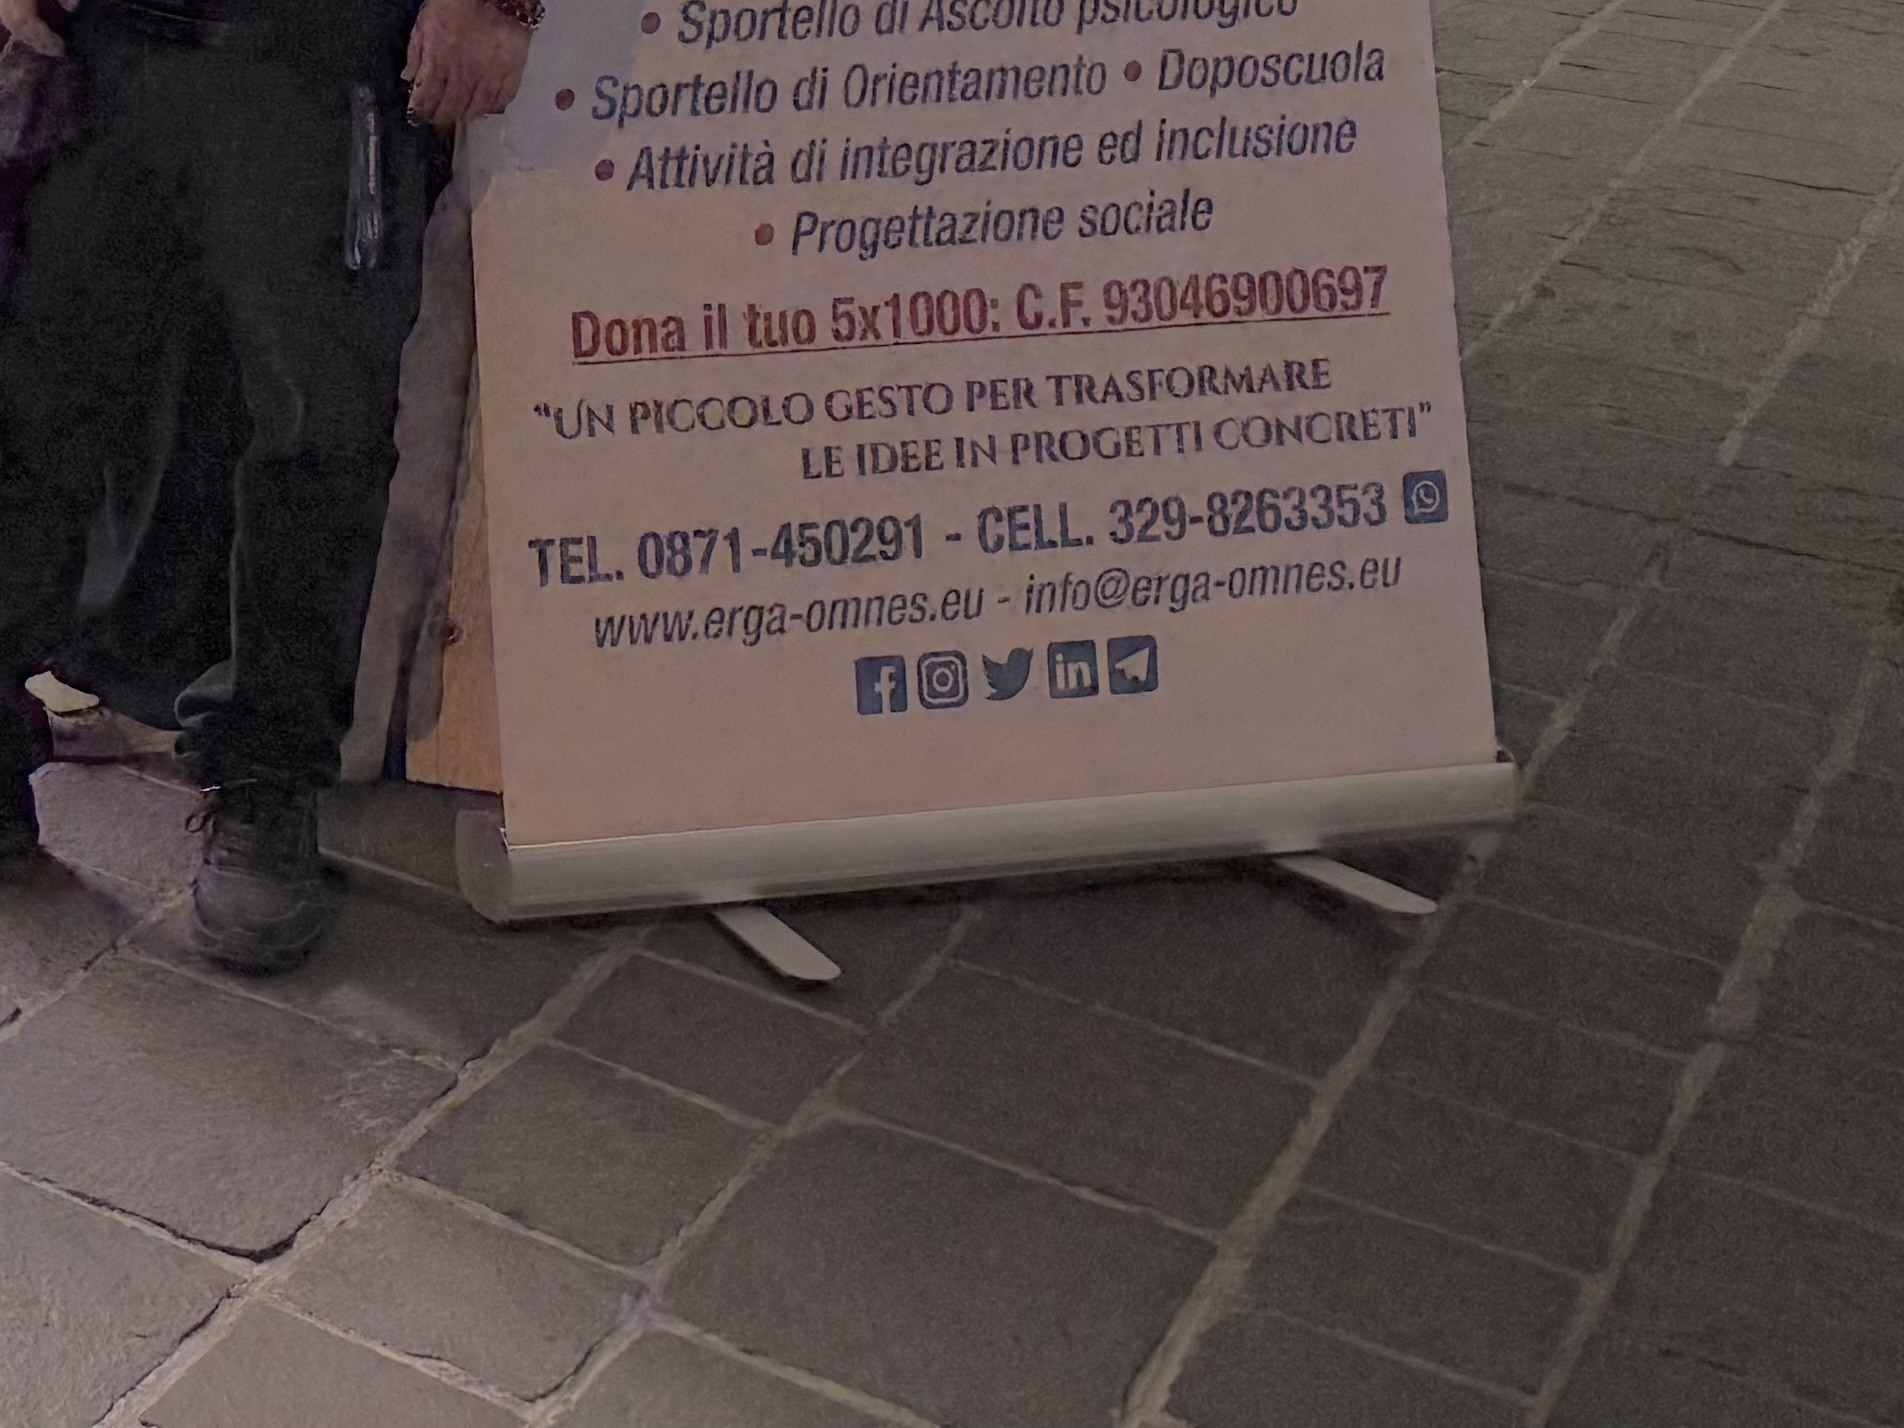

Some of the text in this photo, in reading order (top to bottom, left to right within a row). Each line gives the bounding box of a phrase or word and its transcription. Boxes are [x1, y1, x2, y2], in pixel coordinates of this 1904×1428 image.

[592, 44, 1385, 128] Sportello di Orientamento Doposcuola
[628, 117, 1357, 192] Attività di integrazione ed inclusione
[793, 190, 1213, 259] Progettazione sociale
[571, 266, 1387, 358] Dona tuo 5x1000: C.F. 93046900697
[628, 389, 815, 432] PICCOLO
[825, 382, 954, 422] GESTO
[965, 375, 1037, 412] PER
[1049, 356, 1331, 405] TRASFORMARE
[801, 448, 844, 480] LE
[857, 437, 945, 476] IDEE
[956, 435, 996, 469] IN
[1010, 420, 1203, 465] PROGETTI
[528, 480, 1387, 587] TEL. 0871-450291 CELL. 329-8263353
[594, 553, 1401, 648] www.erga-omnes.eu info@erga-omnes.eu
